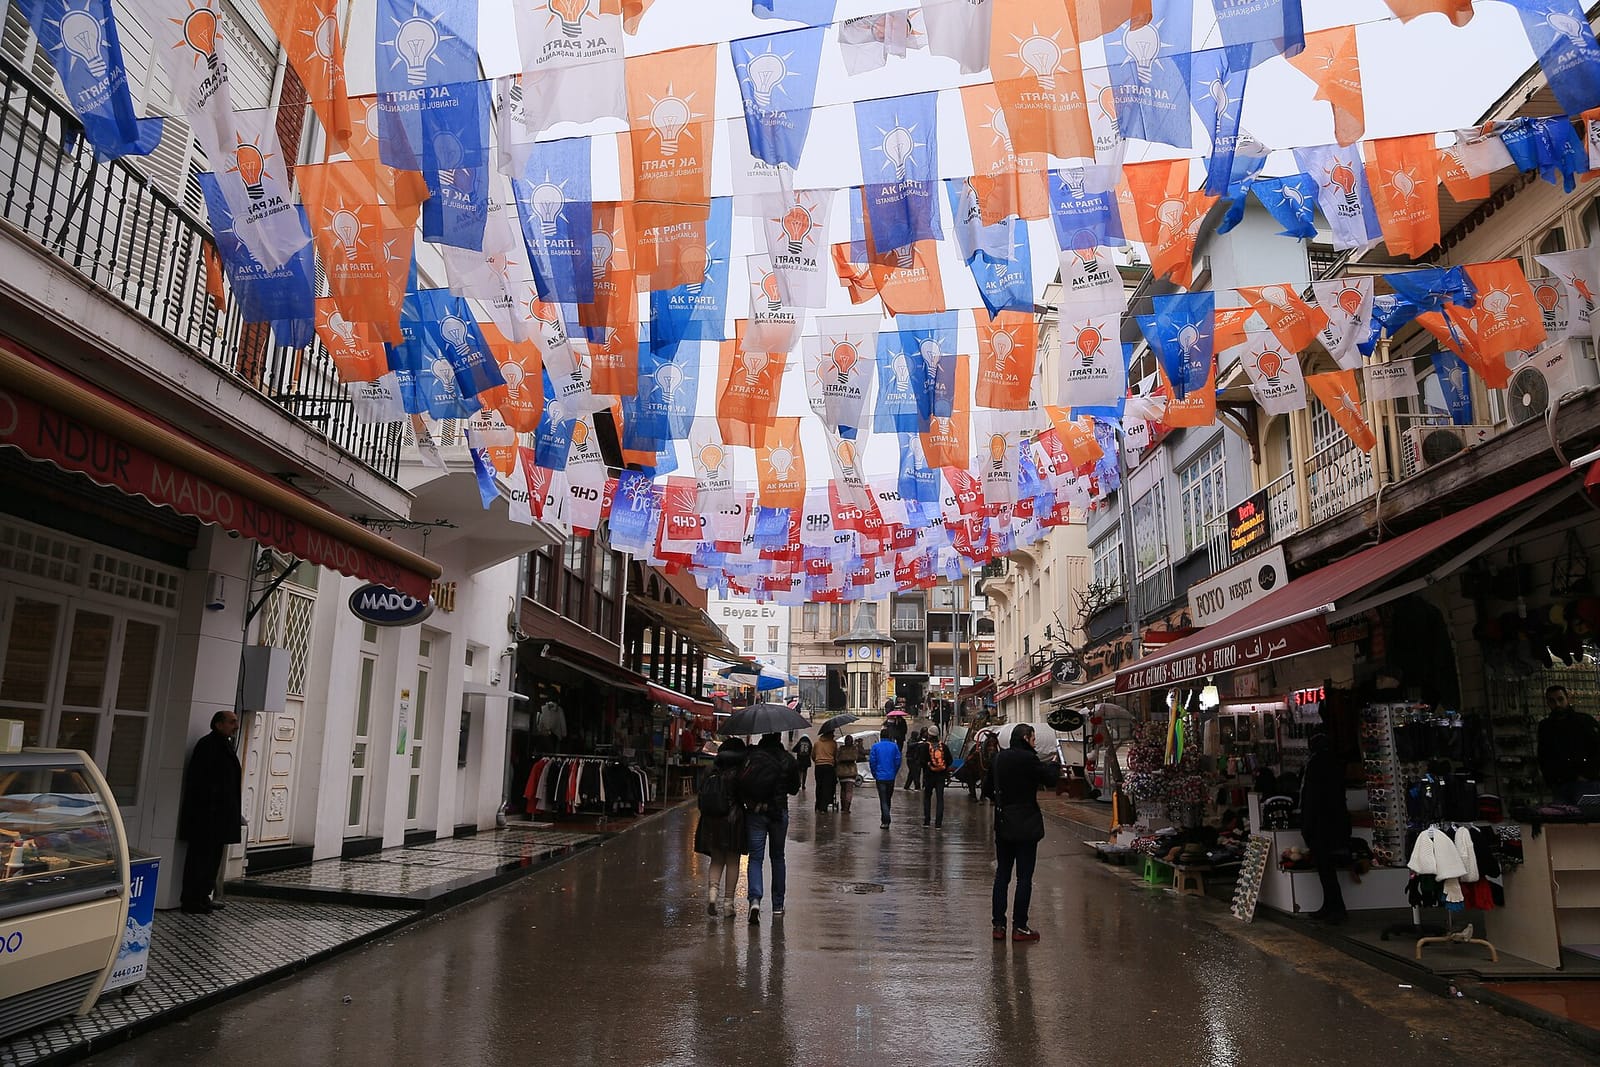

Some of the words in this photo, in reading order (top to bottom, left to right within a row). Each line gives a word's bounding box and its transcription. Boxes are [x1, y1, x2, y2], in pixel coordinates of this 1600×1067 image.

[1558, 50, 1576, 63] AK
[1096, 136, 1111, 144] AK
[1446, 170, 1460, 178] AK
[880, 185, 898, 196] AK
[1060, 201, 1074, 209] AK
[1392, 209, 1407, 218] AK
[644, 228, 660, 236] AK
[239, 265, 251, 273] AK
[883, 272, 897, 281] AK
[1072, 278, 1085, 286] AK
[670, 296, 684, 304] AK
[1372, 368, 1383, 376] AK
[1128, 425, 1145, 435] CHP
[1073, 434, 1084, 444] AK
[37, 410, 131, 483] NDUR
[151, 463, 235, 525] MADO
[242, 503, 298, 551] NDUR
[306, 531, 360, 572] MADO
[945, 497, 956, 506] CH
[864, 519, 882, 528] CHP
[834, 534, 850, 543] CHP
[896, 529, 912, 539] CHP
[975, 546, 989, 555] CHP
[852, 568, 870, 576] CHP
[875, 570, 890, 579] CHP
[896, 568, 910, 576] CHP
[360, 592, 416, 611] MADO
[1196, 587, 1224, 618] FOTO
[1229, 577, 1252, 600] NEŞET
[723, 607, 758, 620] Beyaz
[761, 608, 776, 618] Ev
[1146, 664, 1167, 685] GÜMÜŞ
[1171, 657, 1197, 680] SILVER
[1214, 645, 1236, 669] EURO
[132, 964, 143, 974] 222
